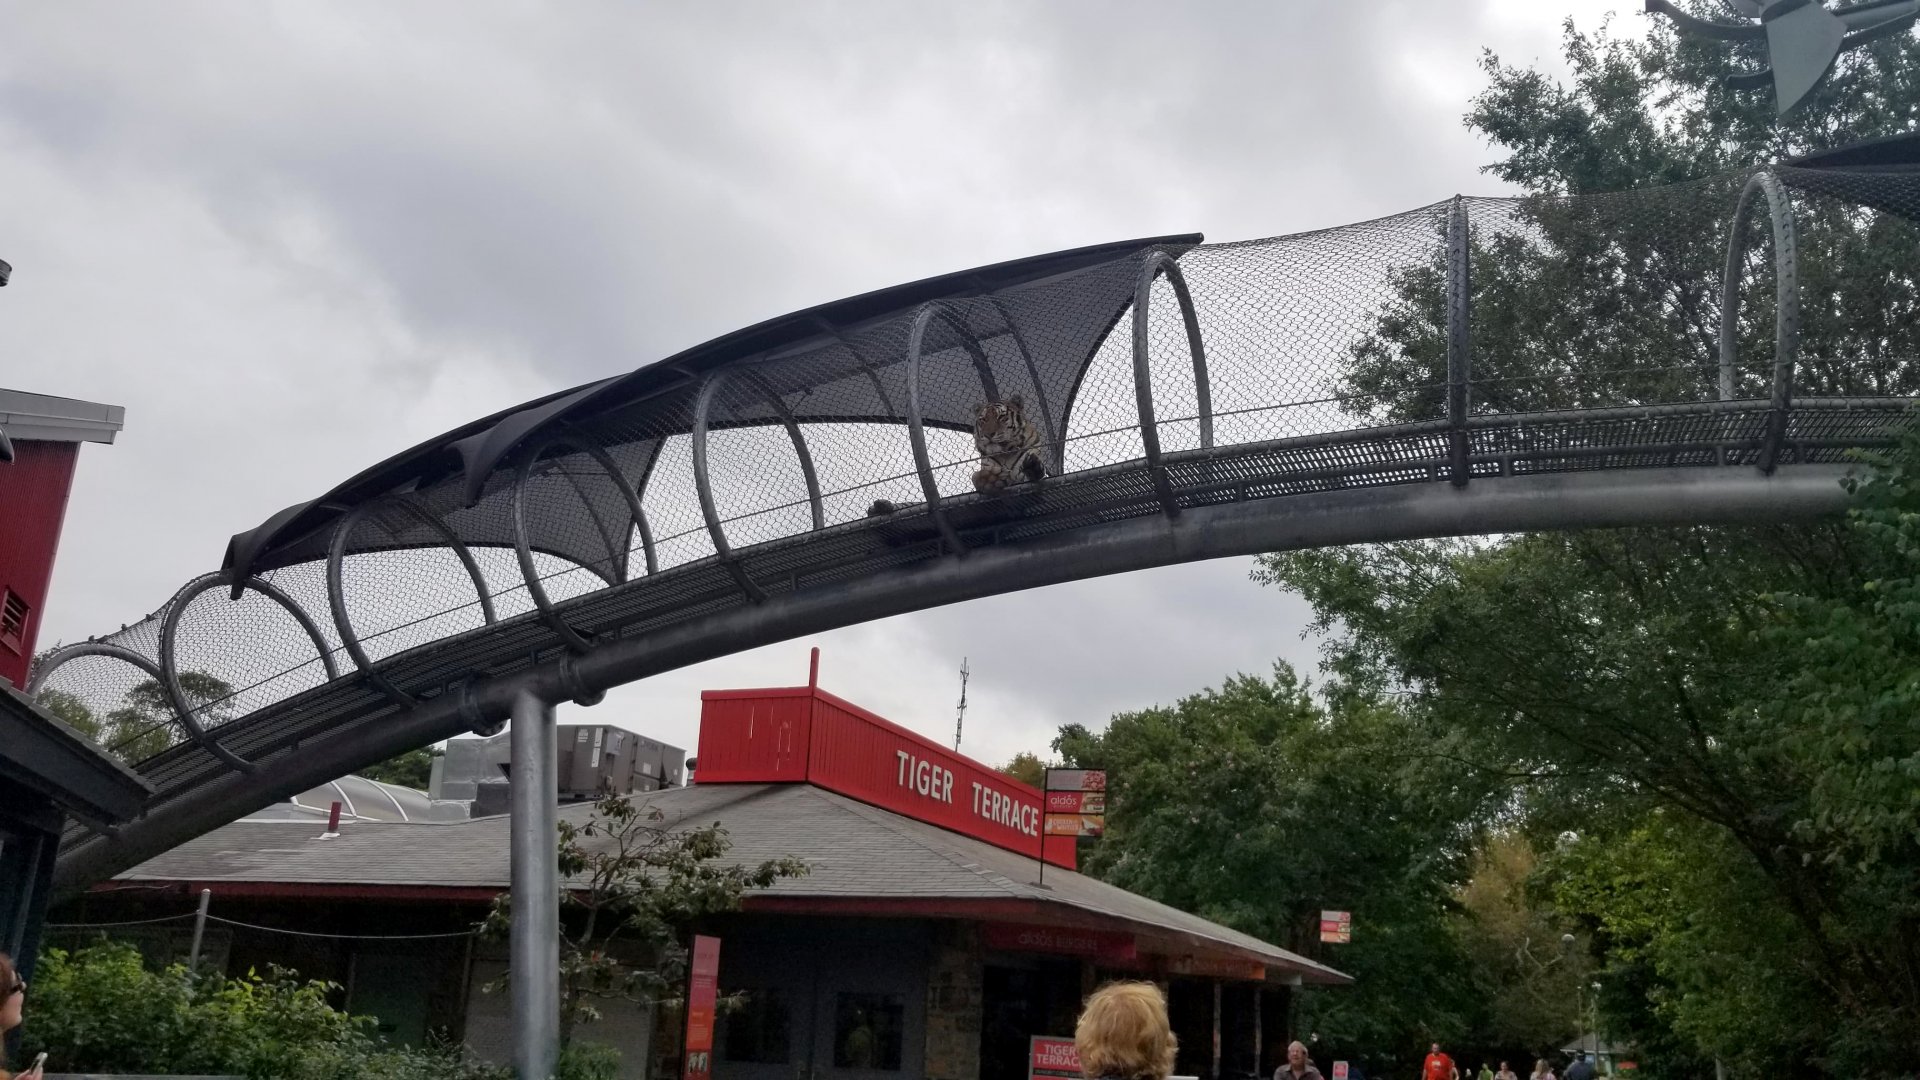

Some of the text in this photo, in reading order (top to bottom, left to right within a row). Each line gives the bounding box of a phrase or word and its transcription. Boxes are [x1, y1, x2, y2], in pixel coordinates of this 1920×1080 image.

[897, 750, 1039, 837] TIGER TERRACE
[1044, 1044, 1077, 1056] TIGER
